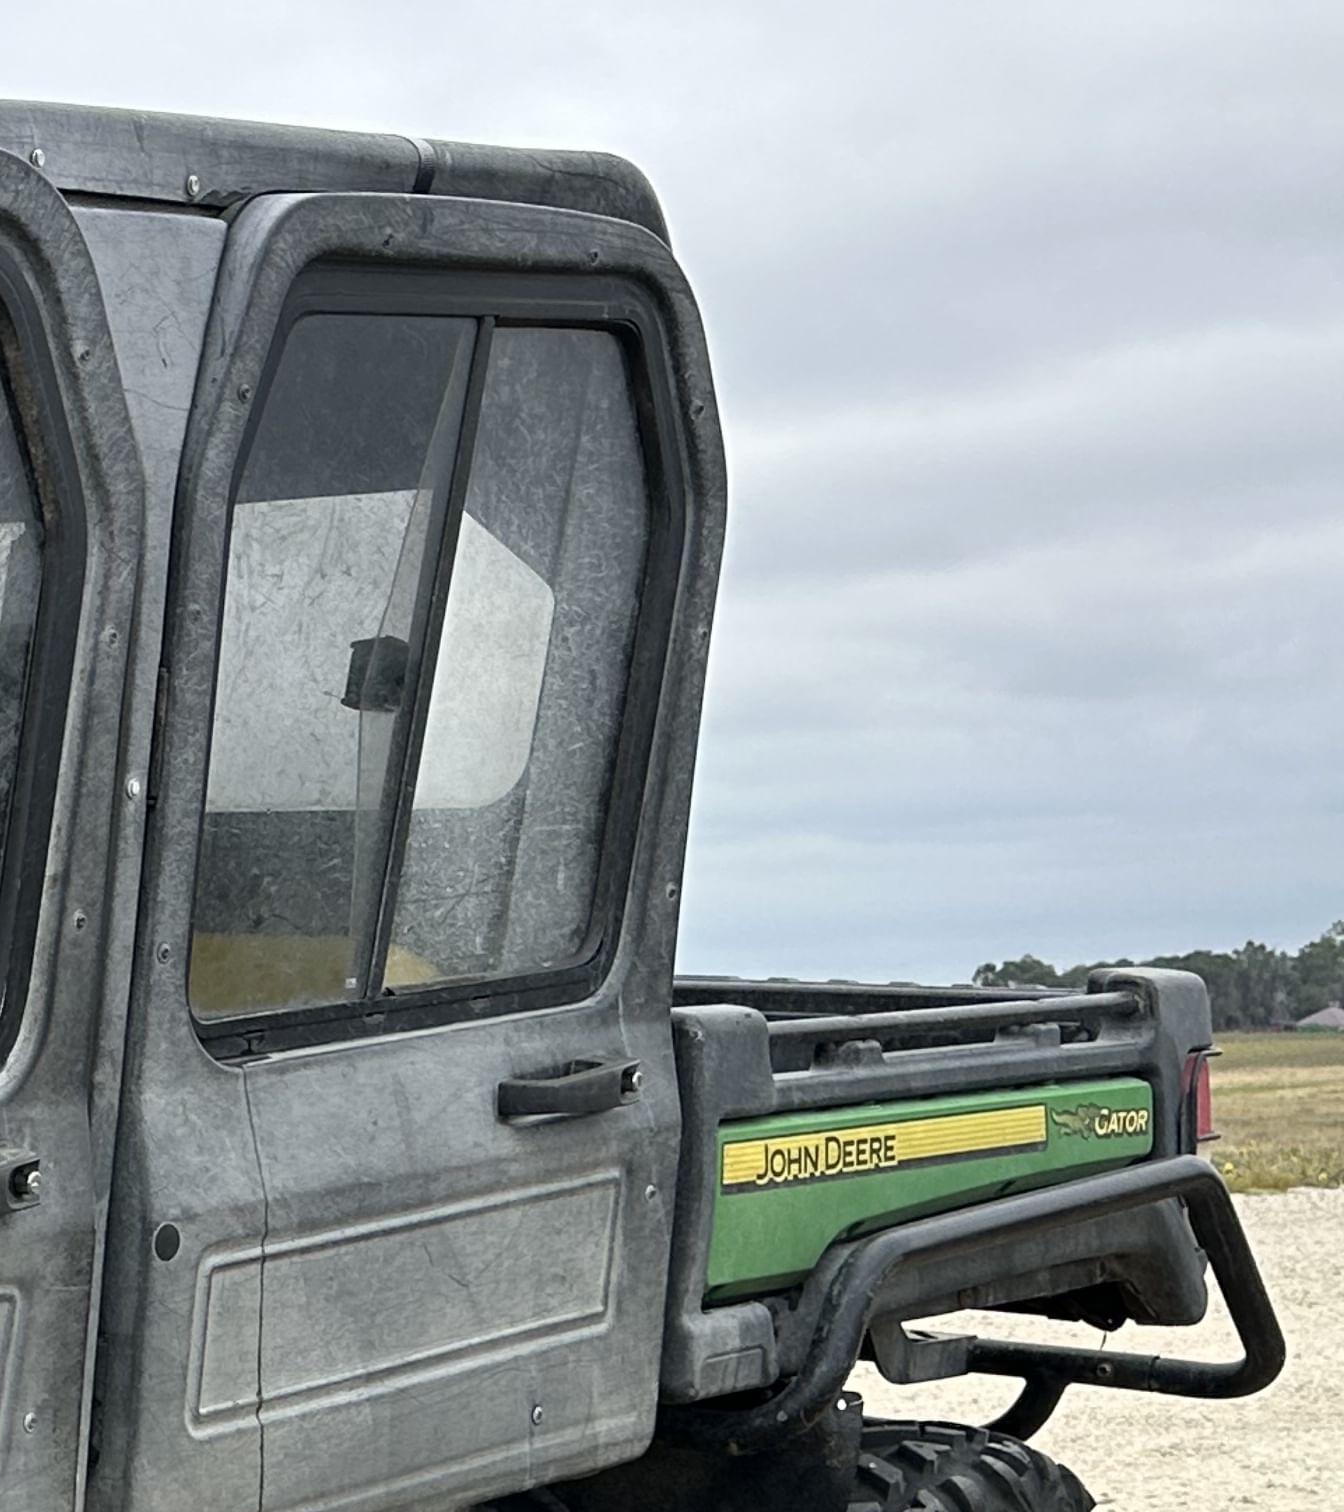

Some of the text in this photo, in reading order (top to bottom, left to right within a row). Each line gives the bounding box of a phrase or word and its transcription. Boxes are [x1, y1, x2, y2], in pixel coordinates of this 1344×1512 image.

[1093, 1107, 1149, 1136] GATOR
[755, 1134, 897, 1184] JOHN DEERE
